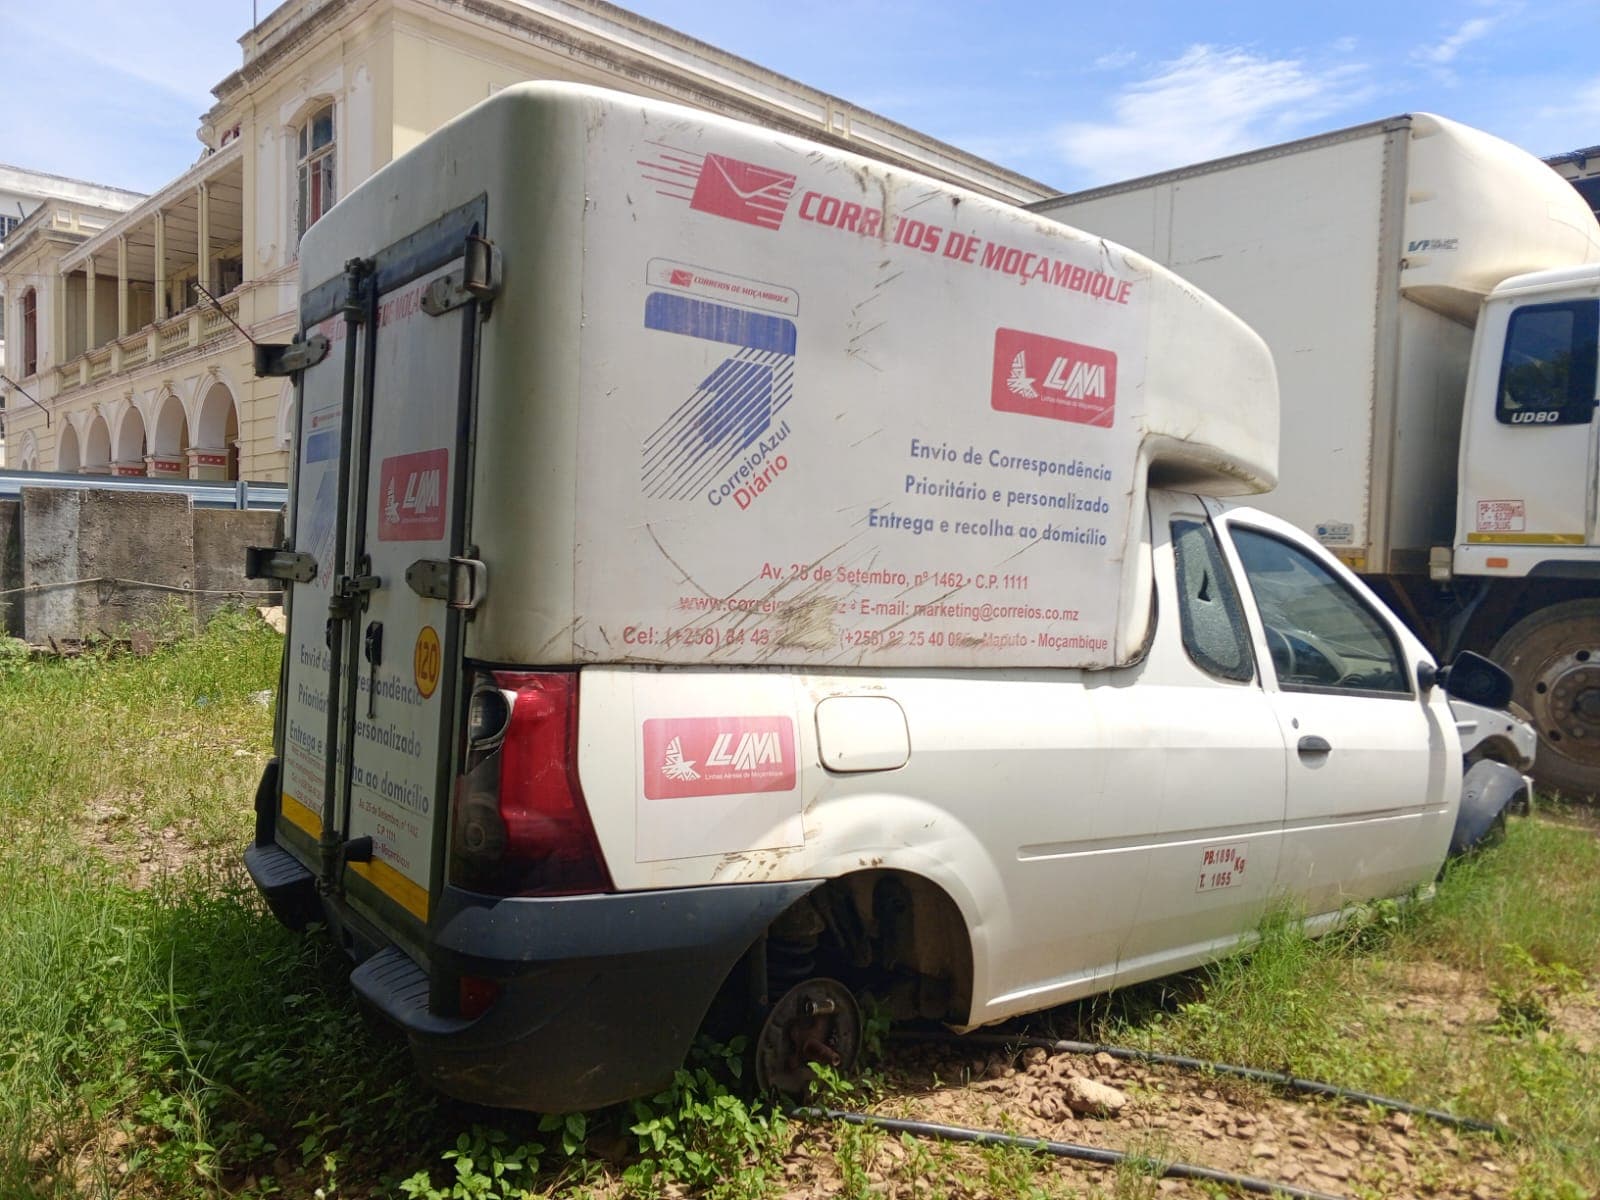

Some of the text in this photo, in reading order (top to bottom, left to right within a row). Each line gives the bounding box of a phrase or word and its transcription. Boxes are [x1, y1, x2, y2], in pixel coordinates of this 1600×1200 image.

[798, 191, 1133, 305] CORRIOS DE MOÇAMBIQUE
[1511, 411, 1559, 423] UD80
[911, 438, 1112, 481] Envio de Correspondência
[732, 455, 788, 511] Diário
[905, 475, 1109, 514] Prioritário e personalizado
[869, 508, 1107, 546] Entrega e recolha ao domicílio
[760, 562, 784, 580] Av.
[790, 564, 808, 581] 25
[813, 566, 831, 582] de
[837, 567, 909, 587] Setembro,
[934, 572, 963, 588] 1462
[976, 574, 999, 589] C.P.
[1004, 574, 1028, 590] 1111
[861, 599, 909, 616] E-mail:
[914, 602, 1079, 621] marketing@correios.co.mz
[301, 644, 320, 669] Envio
[623, 626, 658, 645] Cel:
[909, 631, 925, 647] 25
[928, 631, 944, 647] 40
[1038, 633, 1108, 652] Moçambique
[418, 637, 438, 684] 120
[290, 719, 316, 752] Entrega
[366, 771, 379, 790] ao
[381, 770, 430, 815] domicílio
